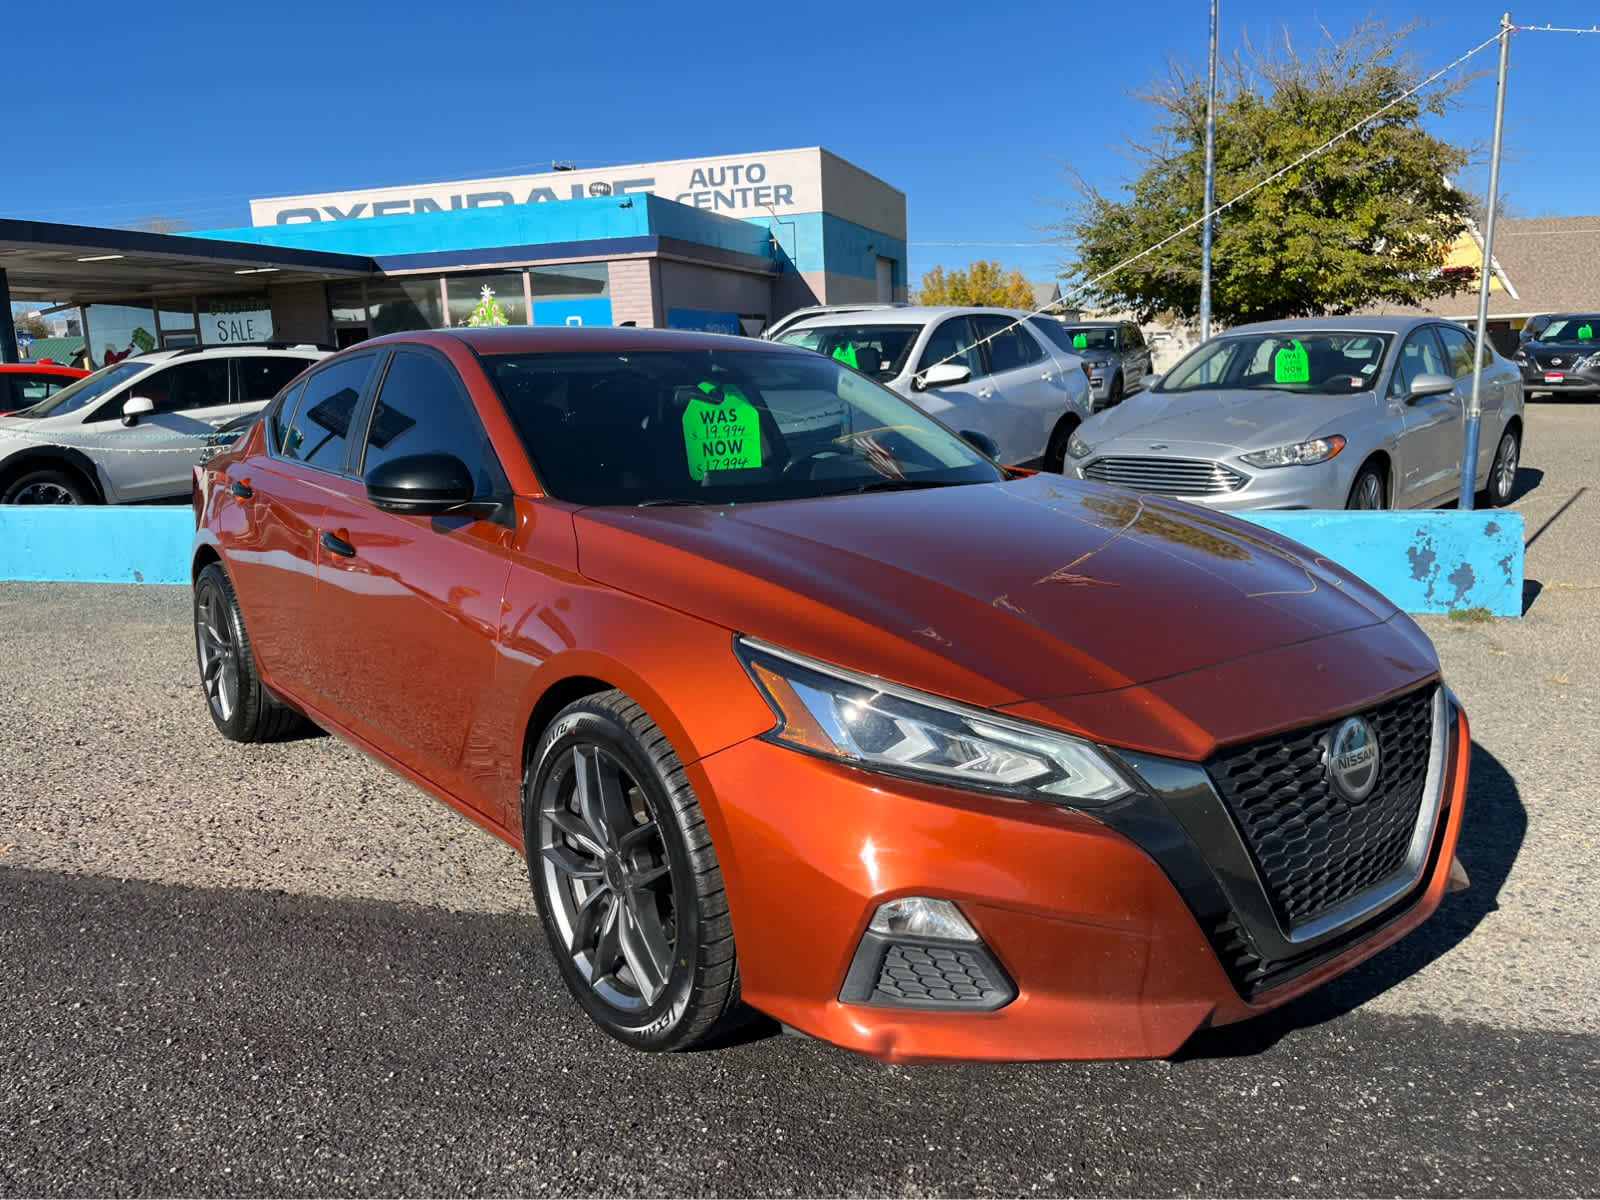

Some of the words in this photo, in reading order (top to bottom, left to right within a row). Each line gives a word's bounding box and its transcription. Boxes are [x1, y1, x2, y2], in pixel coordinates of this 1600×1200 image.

[689, 163, 766, 189] AUTO
[217, 319, 255, 342] SALE
[700, 408, 738, 425] WAS
[702, 440, 743, 457] NOW
[1338, 746, 1376, 769] NISSAN
